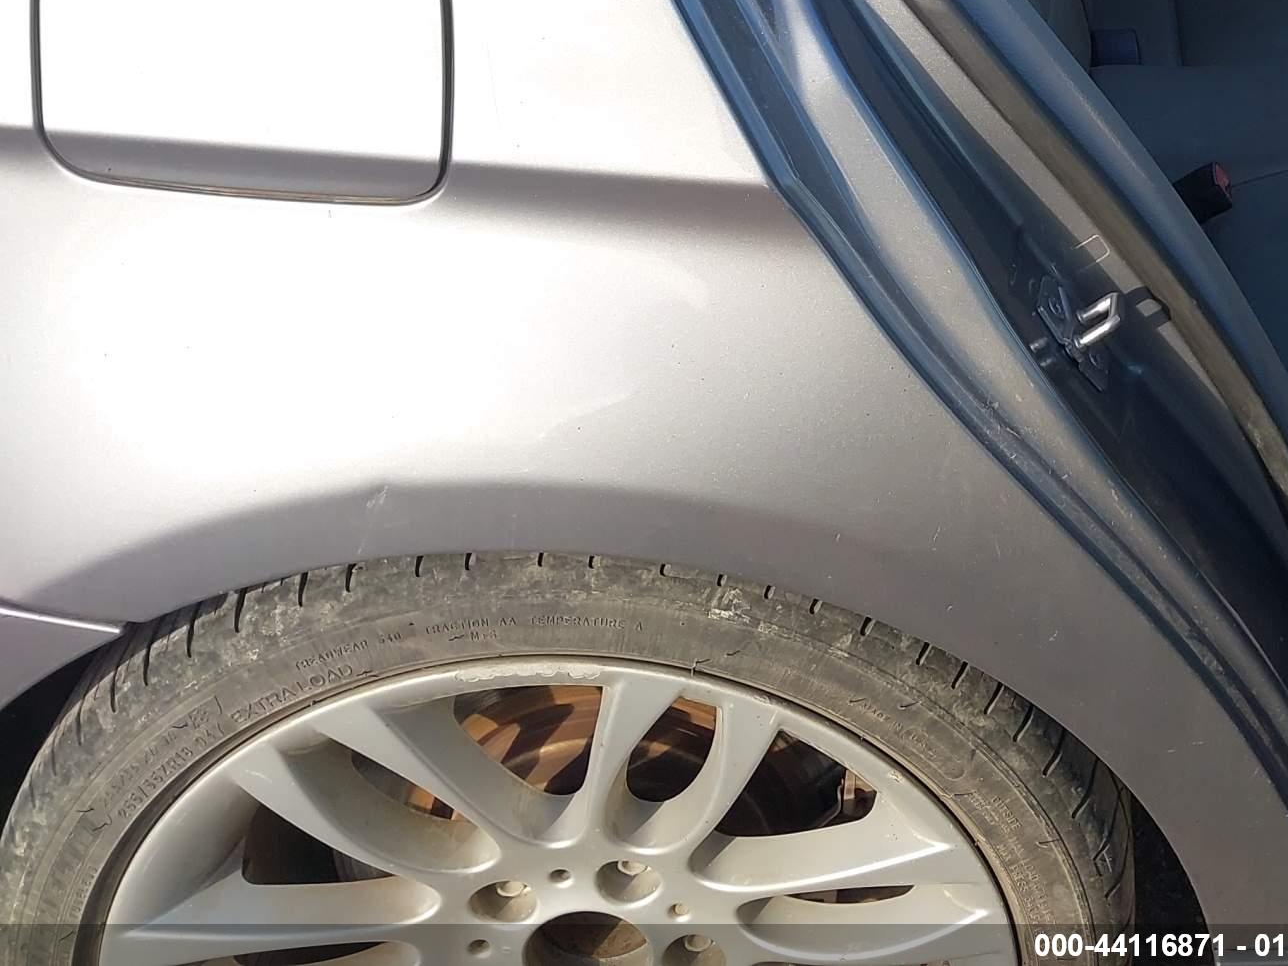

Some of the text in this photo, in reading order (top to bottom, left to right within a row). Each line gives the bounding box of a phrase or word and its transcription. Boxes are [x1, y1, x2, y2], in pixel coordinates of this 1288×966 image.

[425, 617, 490, 635] TRACTION
[530, 615, 626, 631] TEMPERATURE
[231, 664, 353, 724] EXTRA LOAD
